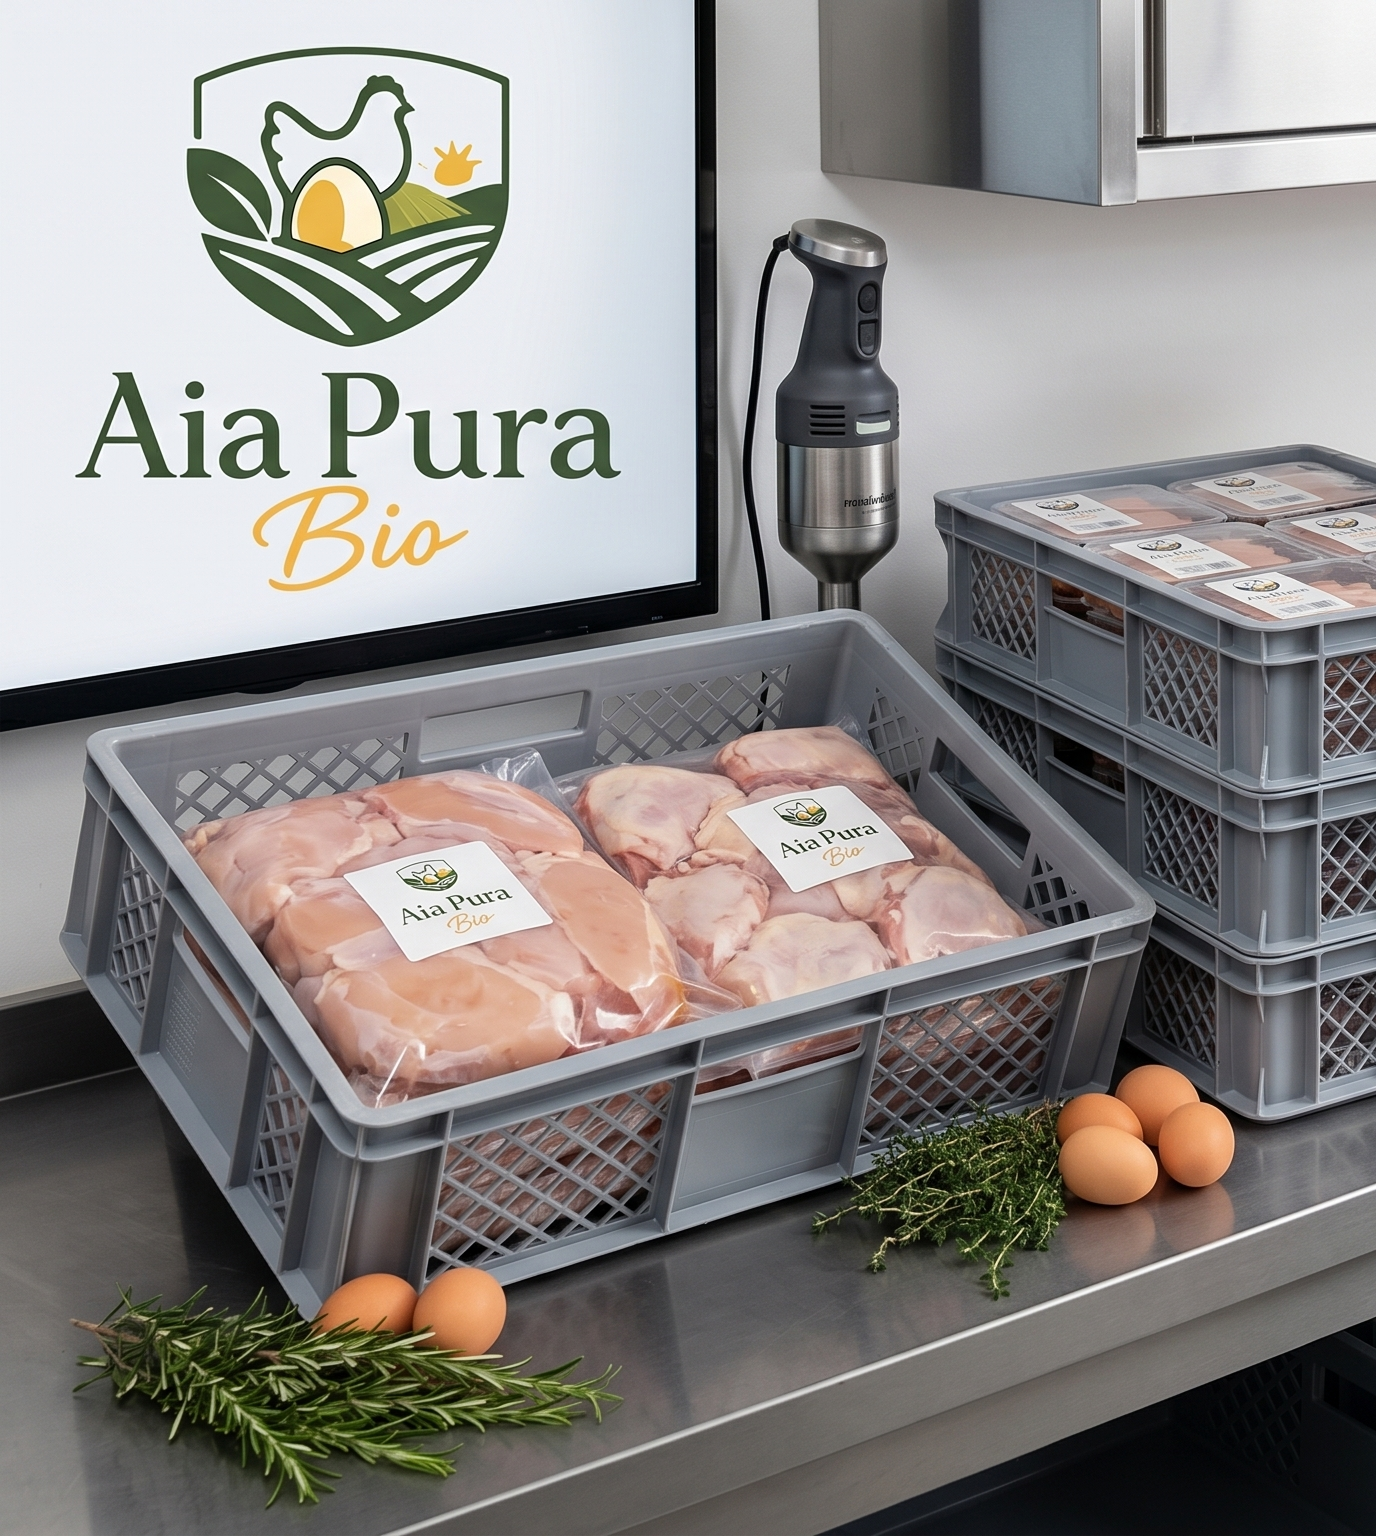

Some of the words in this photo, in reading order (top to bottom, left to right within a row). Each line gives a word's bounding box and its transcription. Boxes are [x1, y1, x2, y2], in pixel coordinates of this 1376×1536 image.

[75, 371, 291, 480] Aia
[321, 371, 622, 480] Pura
[251, 484, 470, 592] Bio
[781, 838, 822, 859] Aia
[818, 824, 879, 845] Pura
[822, 845, 865, 867] Bio
[402, 904, 447, 926] Aia
[445, 887, 513, 911] Pura
[446, 912, 495, 935] Bio
